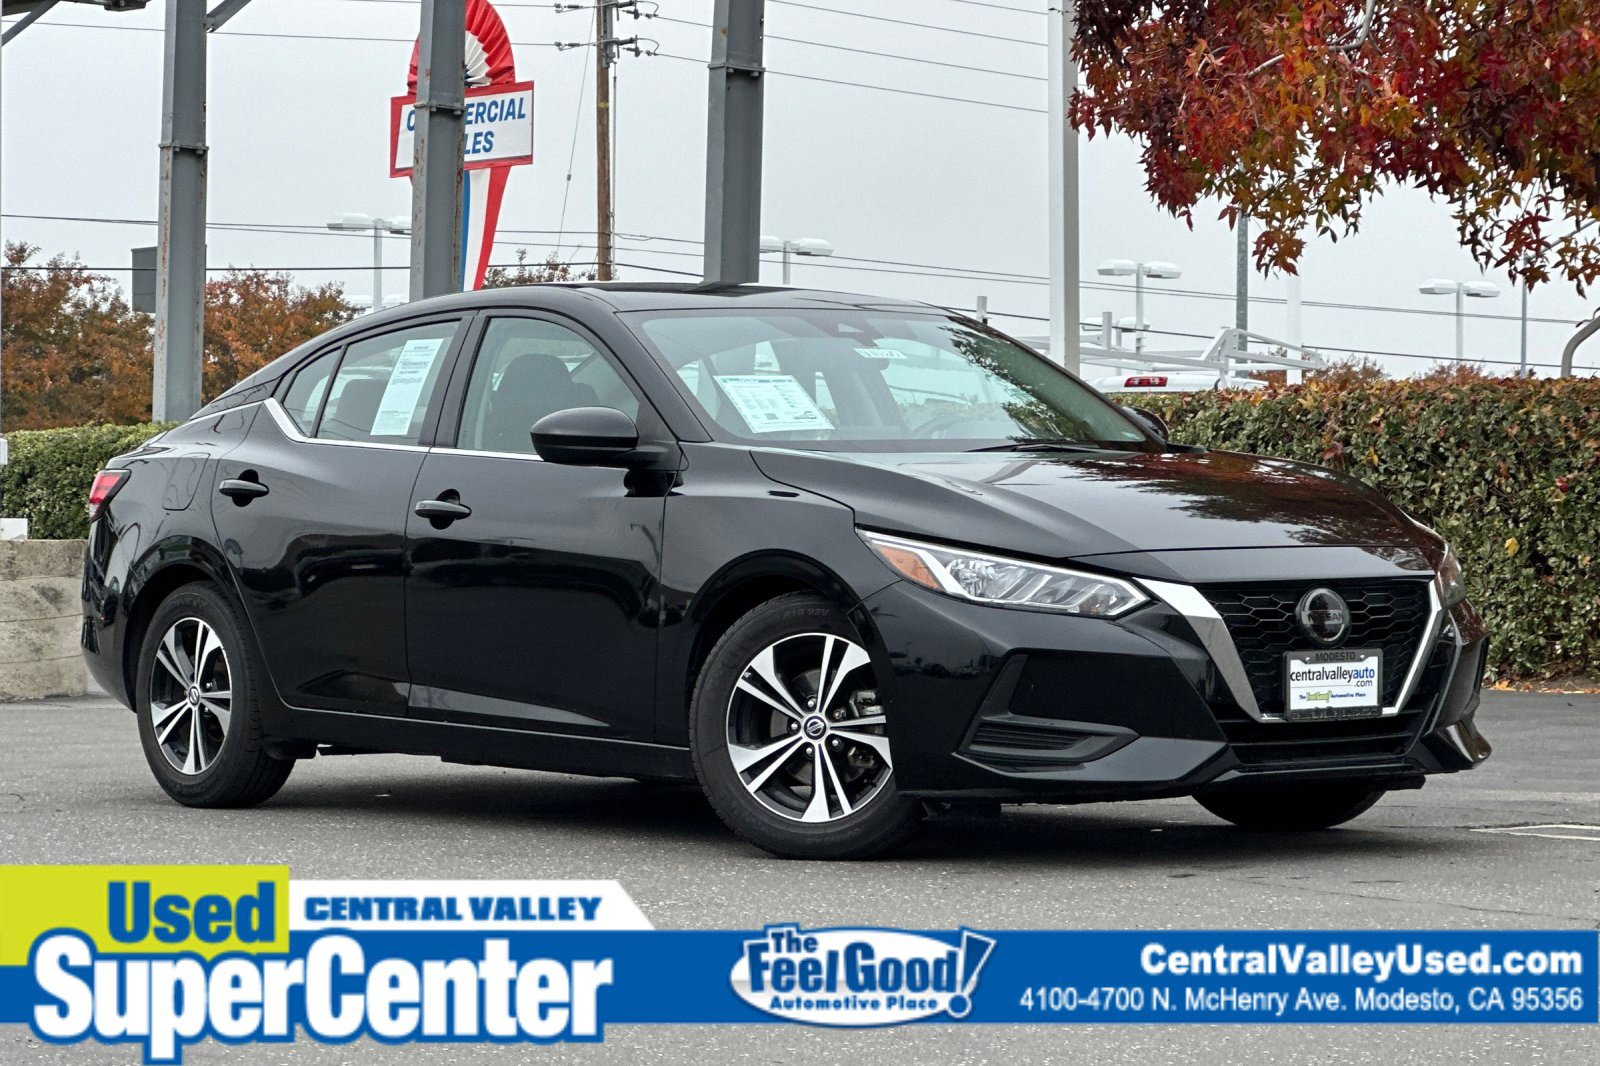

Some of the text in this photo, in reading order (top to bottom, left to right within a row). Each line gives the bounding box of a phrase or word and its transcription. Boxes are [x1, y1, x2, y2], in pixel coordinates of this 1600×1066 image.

[407, 97, 526, 131] CERCIAL
[464, 131, 495, 155] LES
[1315, 652, 1356, 661] MODESTO
[1290, 666, 1375, 683] centralvalleyauto
